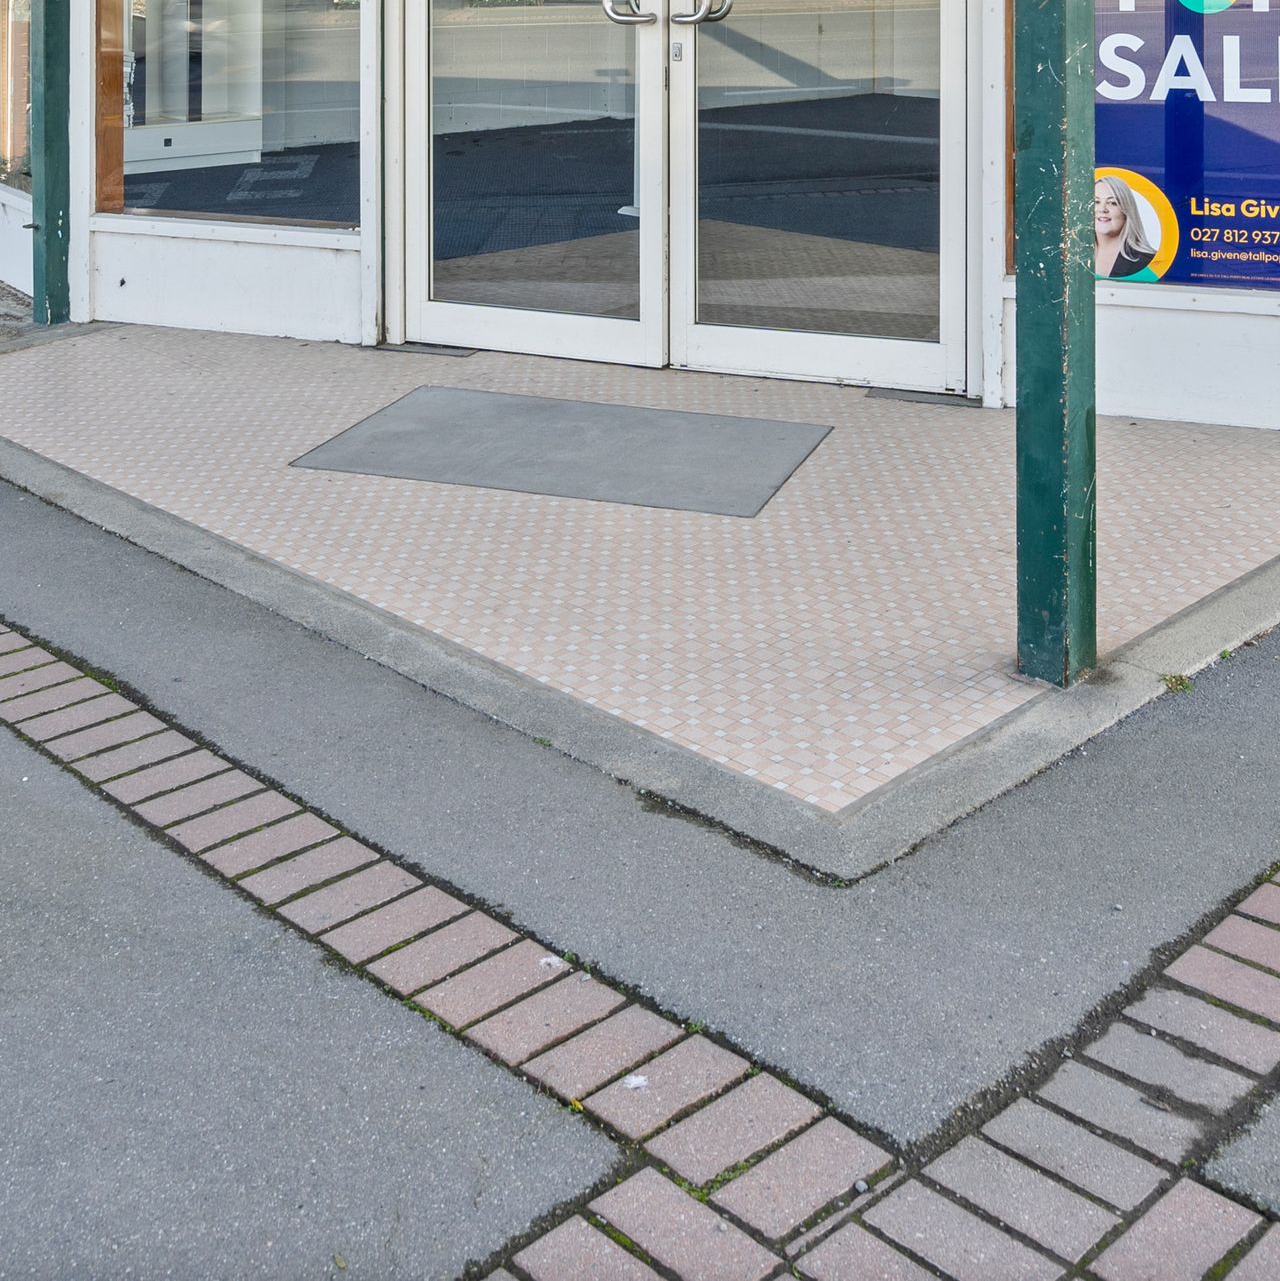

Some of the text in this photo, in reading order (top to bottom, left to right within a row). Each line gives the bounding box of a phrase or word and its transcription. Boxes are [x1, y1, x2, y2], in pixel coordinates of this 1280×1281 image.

[1190, 197, 1235, 217] Lisa
[1190, 228, 1220, 242] 027
[1223, 229, 1248, 243] 812
